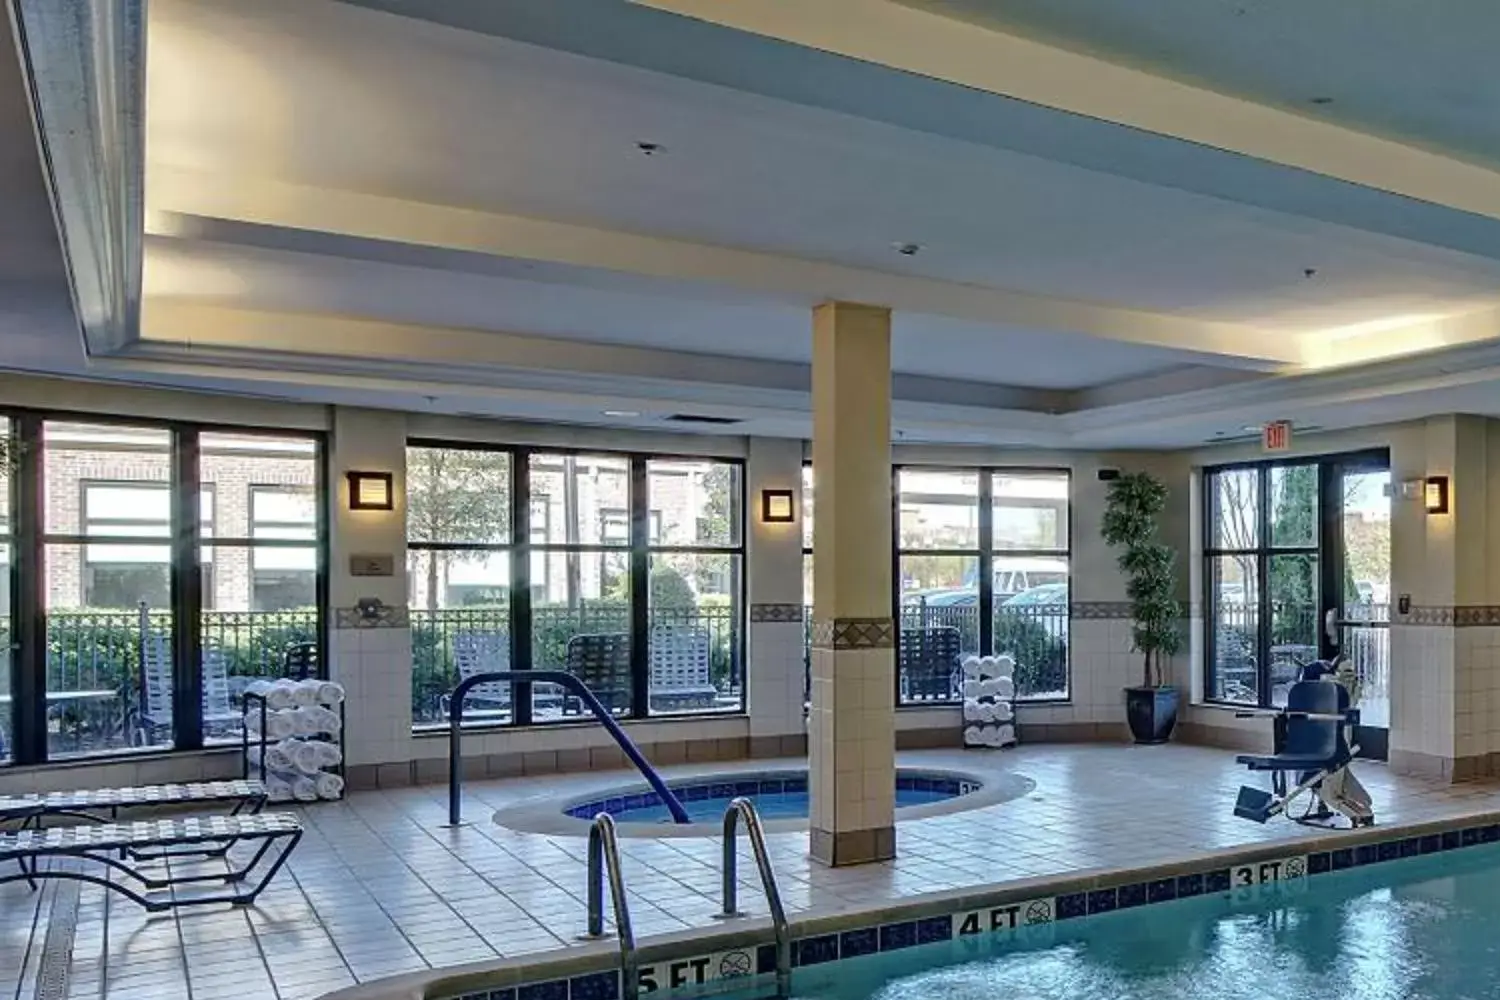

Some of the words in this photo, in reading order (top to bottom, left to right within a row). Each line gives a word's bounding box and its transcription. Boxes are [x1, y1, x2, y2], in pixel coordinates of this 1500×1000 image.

[1236, 867, 1253, 886] 3
[1260, 862, 1281, 885] FT
[959, 911, 983, 935] 4
[990, 906, 1021, 931] FT
[670, 957, 711, 988] FT
